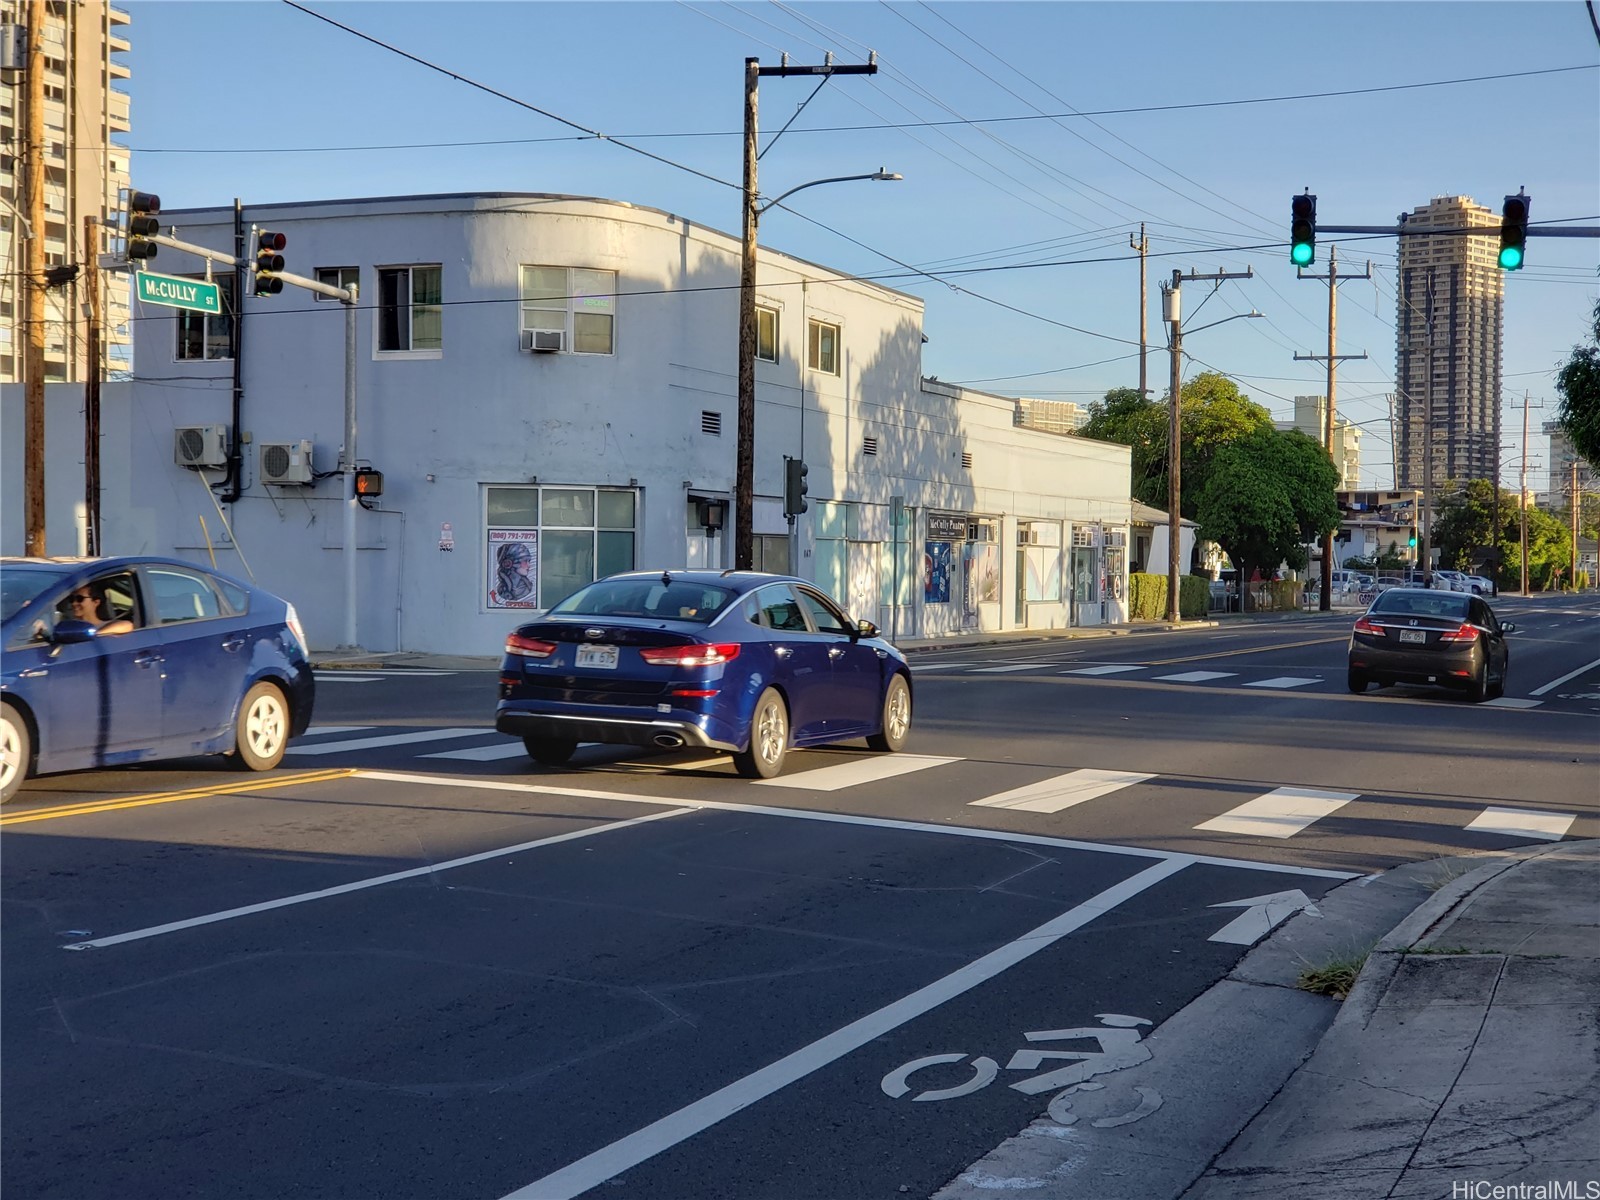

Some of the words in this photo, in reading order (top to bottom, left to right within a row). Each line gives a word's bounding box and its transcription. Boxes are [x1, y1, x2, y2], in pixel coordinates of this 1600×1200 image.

[145, 279, 196, 302] McCULLY
[205, 296, 214, 305] ST
[930, 518, 948, 531] McCully
[949, 520, 964, 531] Pantry
